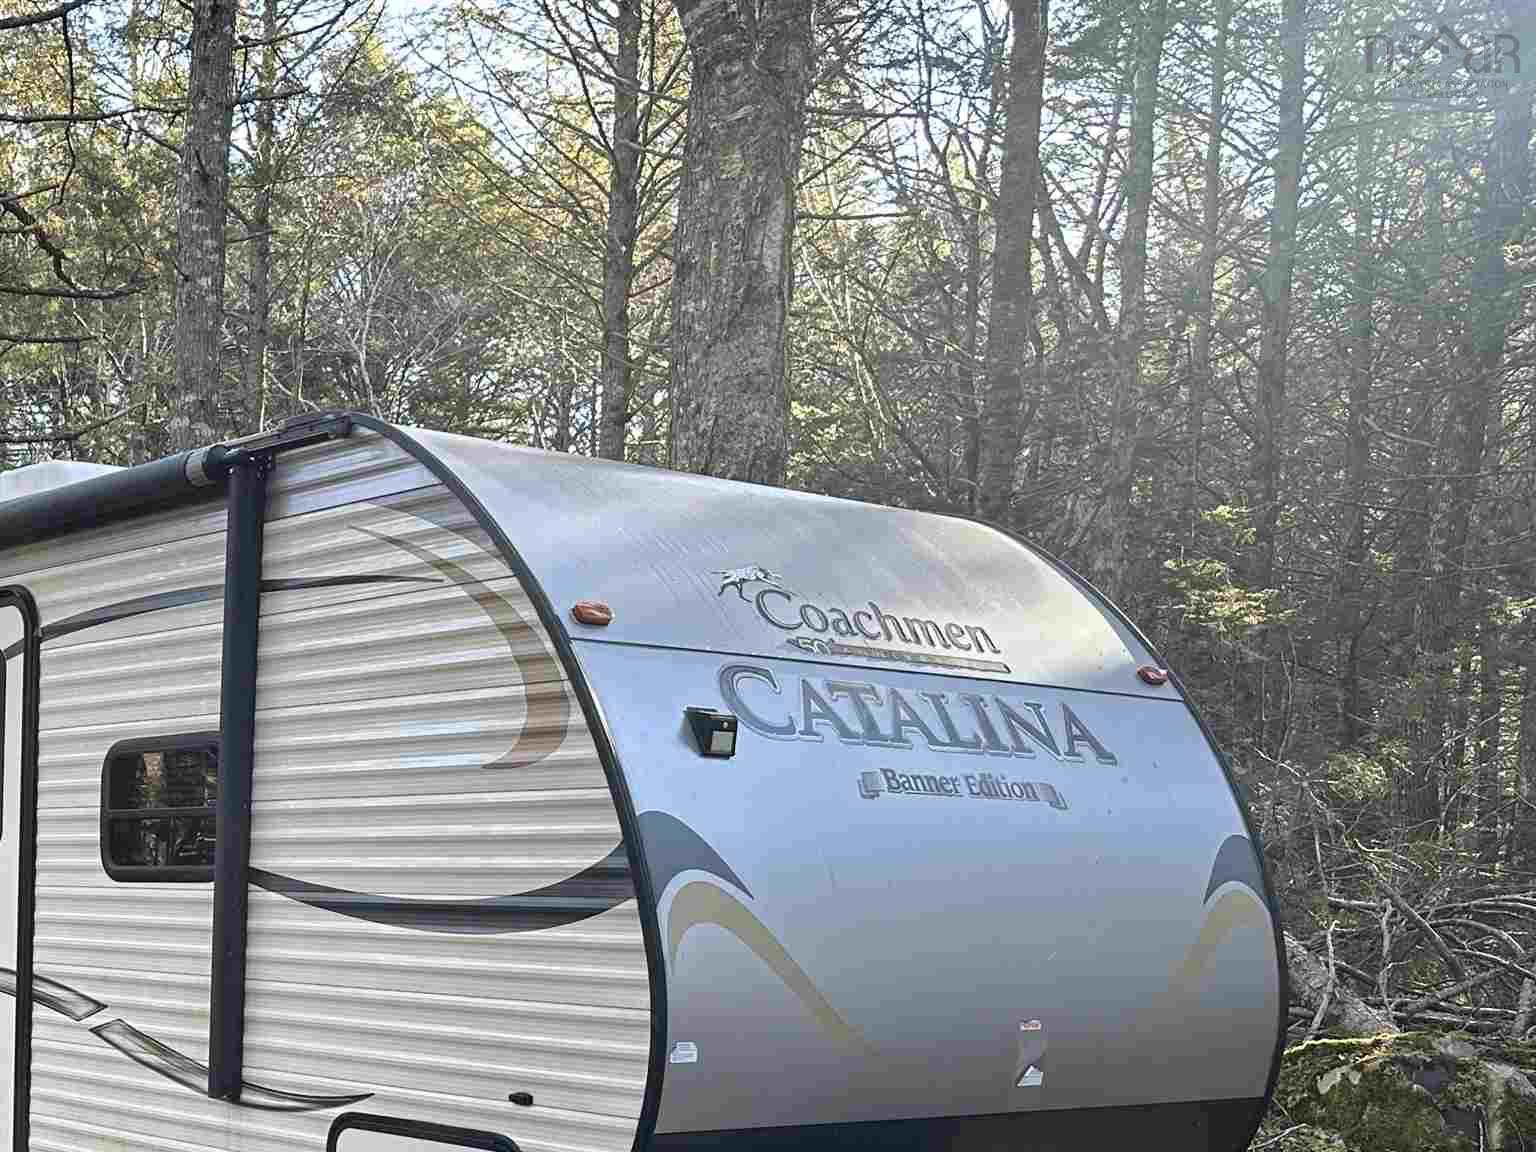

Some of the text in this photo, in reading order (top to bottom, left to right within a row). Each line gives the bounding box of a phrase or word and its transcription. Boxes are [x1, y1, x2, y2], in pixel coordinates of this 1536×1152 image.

[755, 588, 1001, 654] Coachmen
[718, 663, 1118, 767] CATALINA
[880, 768, 1039, 801] Banner Edition
